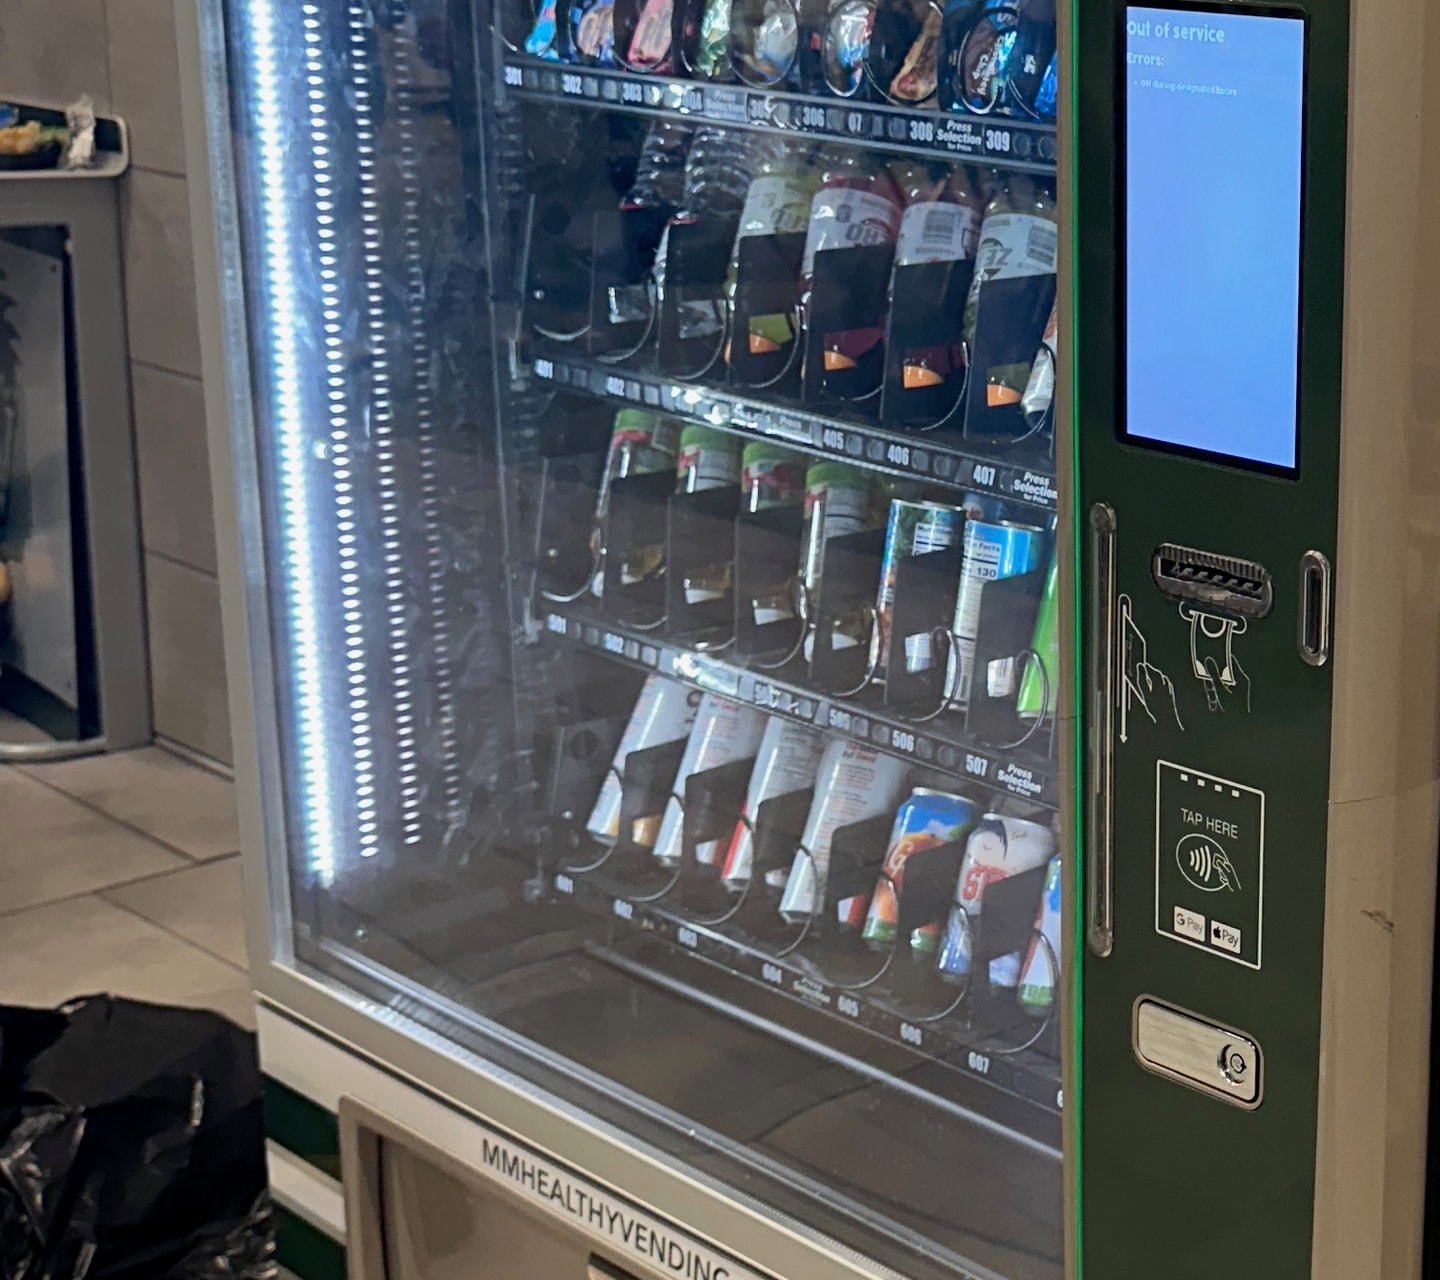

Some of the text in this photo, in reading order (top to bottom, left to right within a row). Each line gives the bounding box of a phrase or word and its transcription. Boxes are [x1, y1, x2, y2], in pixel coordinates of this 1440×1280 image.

[1127, 20, 1225, 43] Out of service
[1127, 52, 1165, 66] Errors:
[562, 75, 583, 95] 302
[622, 82, 643, 102] 303
[803, 107, 825, 127] 306
[947, 120, 972, 132] Press
[910, 121, 933, 142] 308
[936, 129, 981, 145] Selection
[986, 129, 1010, 152] 309
[823, 431, 844, 450] 405
[887, 444, 909, 465] 406
[973, 465, 996, 487] 407
[1024, 472, 1049, 487] Press
[977, 567, 997, 578] 130
[893, 729, 914, 752] 506
[966, 755, 988, 776] 507
[1008, 763, 1033, 780] Press
[997, 769, 1042, 794] Selection
[1181, 808, 1239, 840] TAP HERE
[1223, 929, 1239, 948] Pay
[968, 1052, 989, 1075] 607
